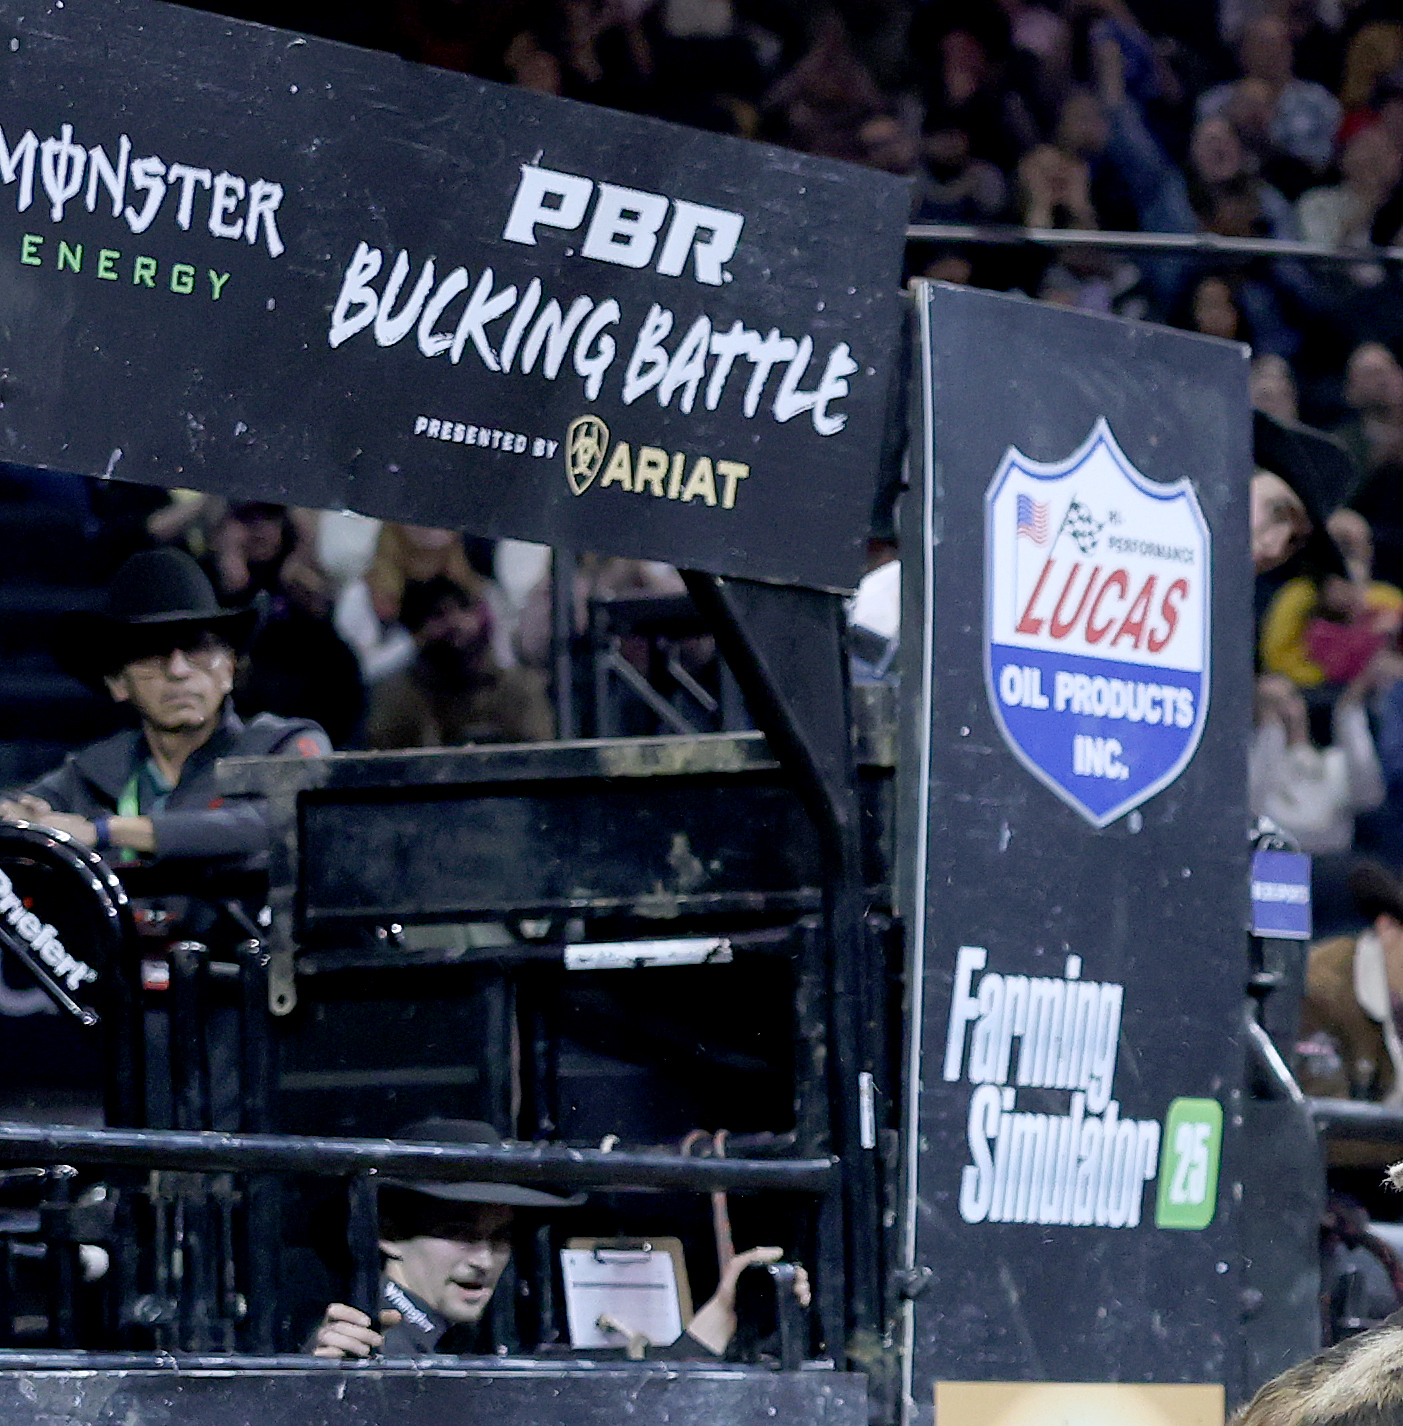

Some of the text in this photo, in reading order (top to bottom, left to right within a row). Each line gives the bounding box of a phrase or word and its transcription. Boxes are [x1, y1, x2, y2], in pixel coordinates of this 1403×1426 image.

[0, 123, 285, 258] MONSTER
[503, 165, 744, 284] PBR
[20, 233, 231, 300] ENERGY
[330, 242, 860, 436] BUCKING BATTLE
[414, 415, 560, 459] PRESENTED BY
[601, 440, 751, 510] ARIAT
[1108, 534, 1195, 562] PERFORMANCE
[1016, 558, 1191, 653] LUCAS
[1001, 664, 1195, 729] OIL PRODUCTS
[1073, 735, 1130, 781] INC.
[943, 946, 1123, 1113] Farming
[959, 1084, 1161, 1228] Simulator
[1169, 1121, 1211, 1205] 25
